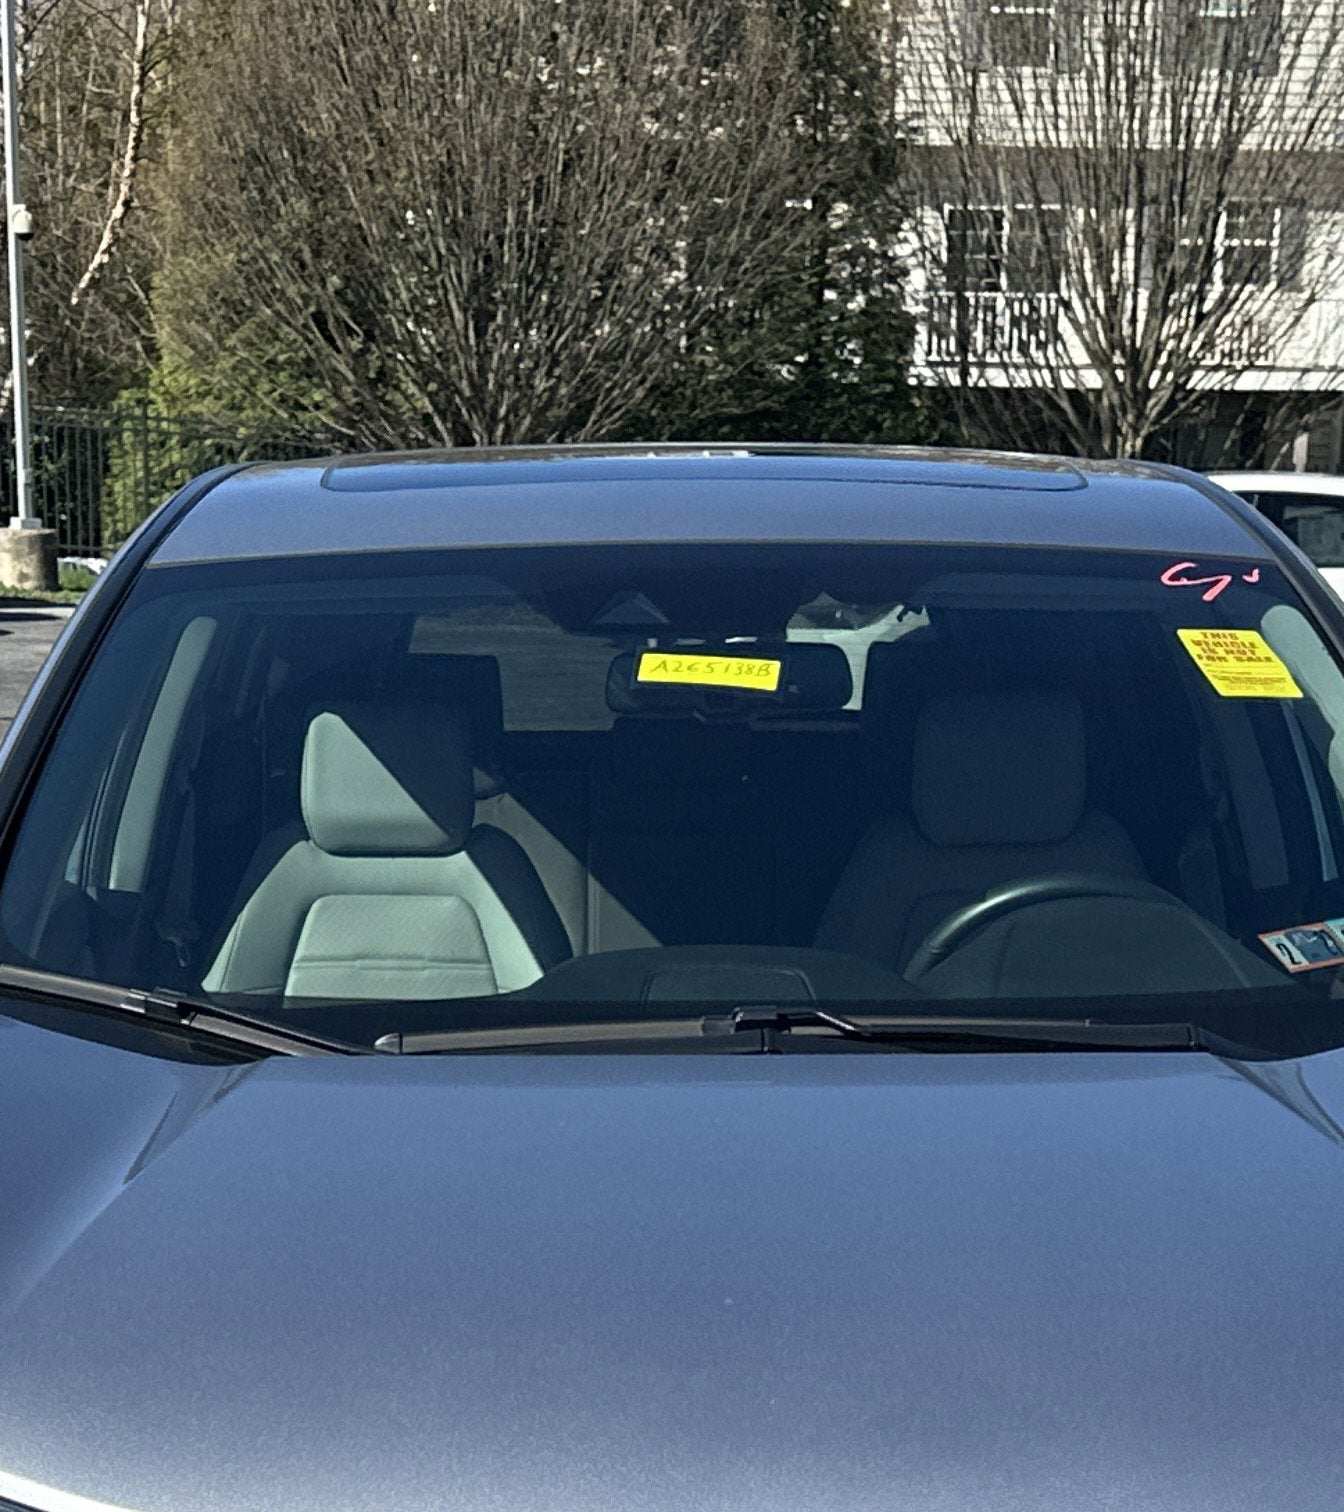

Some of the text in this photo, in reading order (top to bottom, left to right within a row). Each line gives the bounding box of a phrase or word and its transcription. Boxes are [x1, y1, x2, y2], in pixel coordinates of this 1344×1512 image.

[1200, 632, 1239, 640] THIS
[1191, 639, 1259, 649] VEHICLE
[1200, 647, 1257, 656] IS NOT
[1196, 653, 1229, 663] FOR
